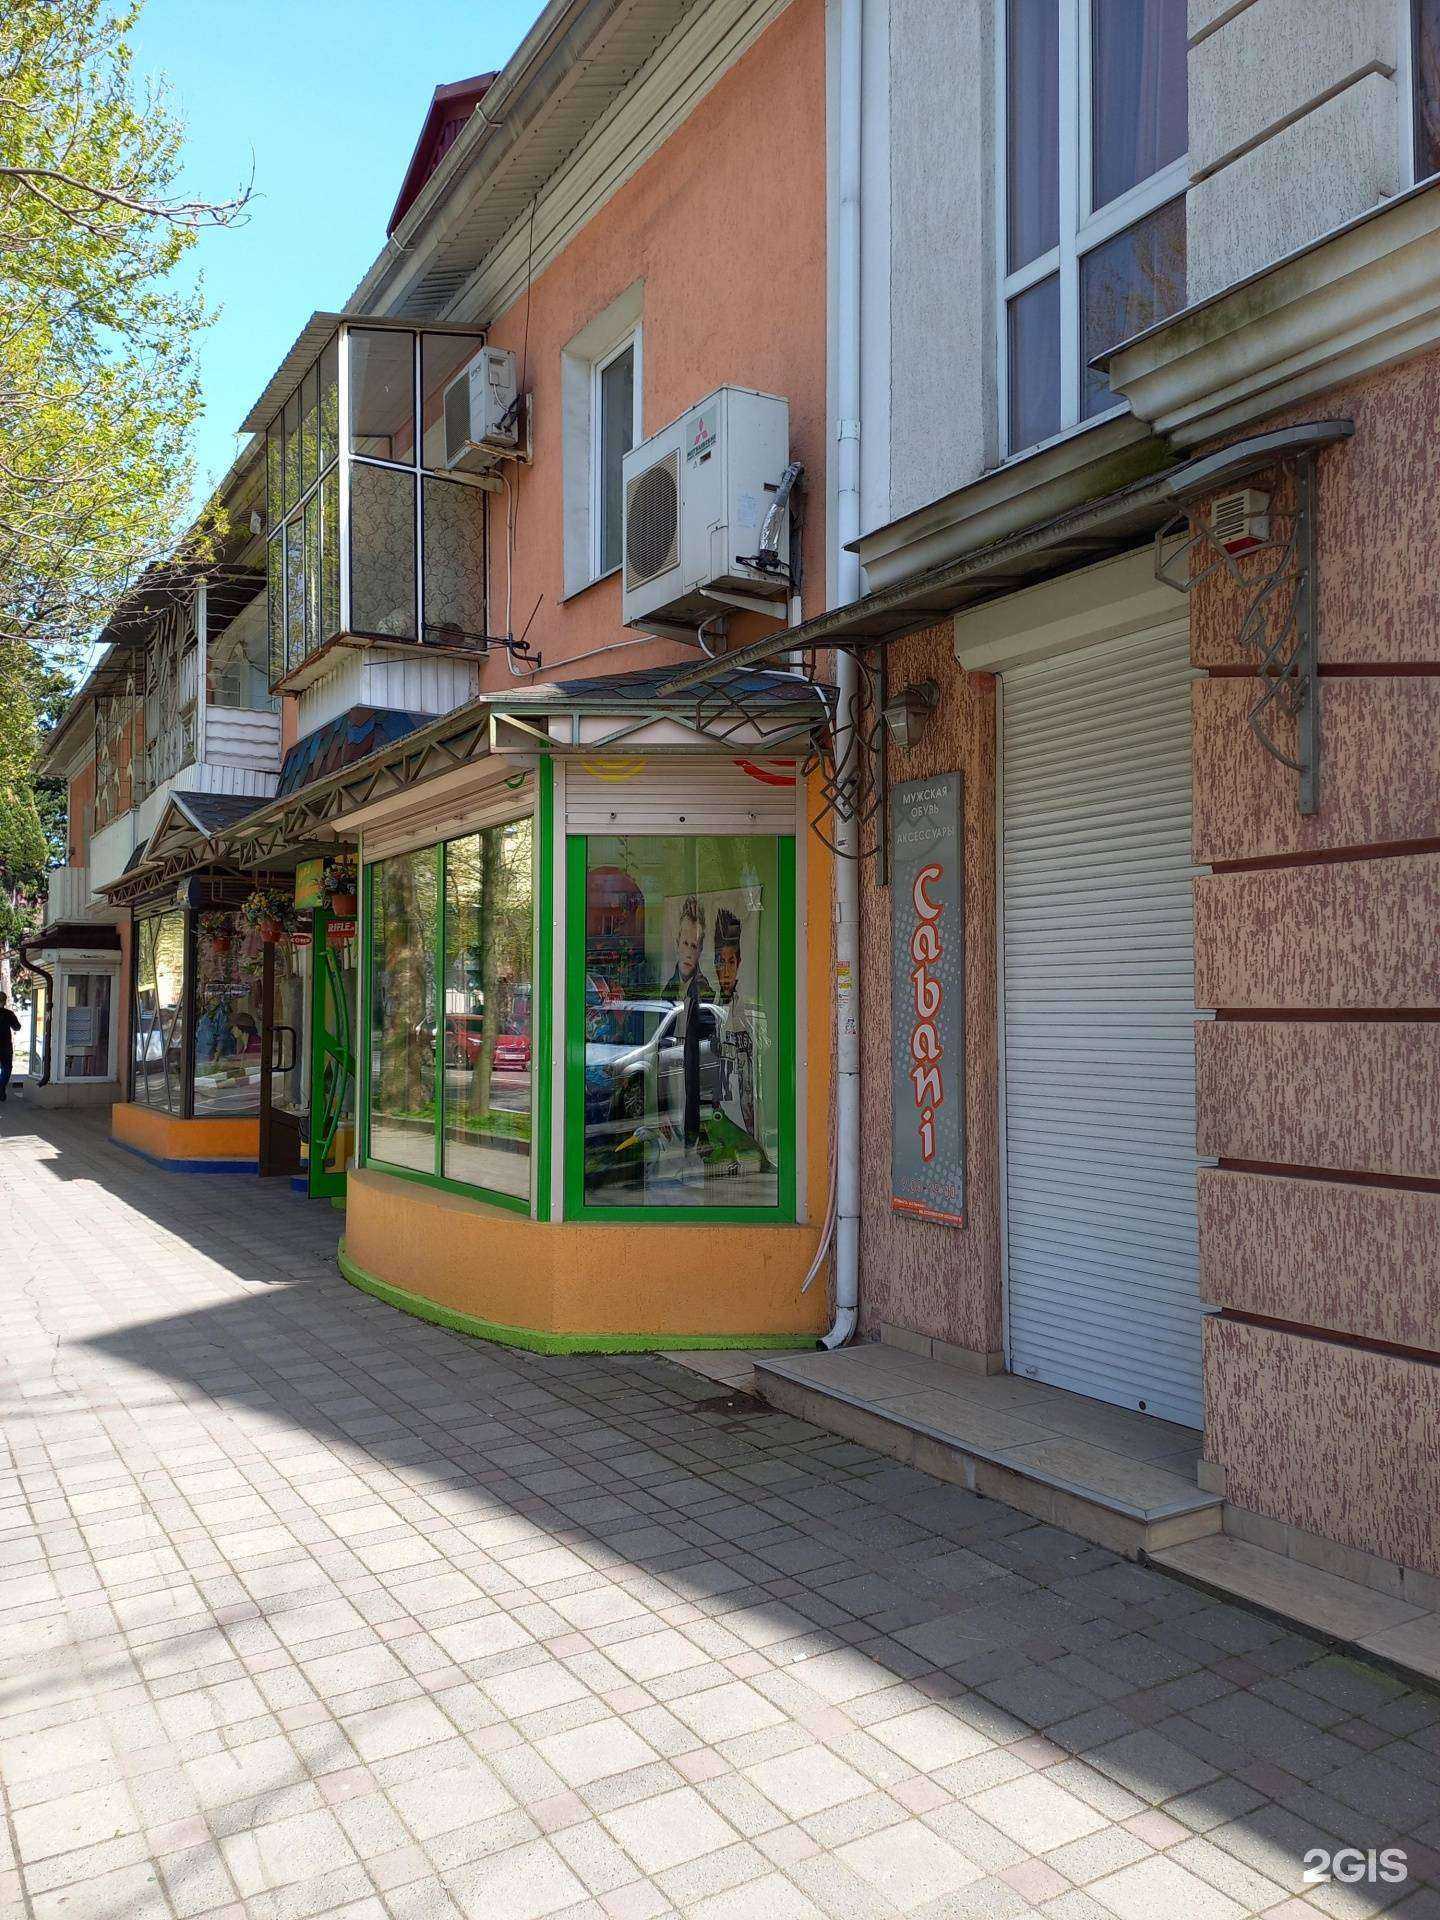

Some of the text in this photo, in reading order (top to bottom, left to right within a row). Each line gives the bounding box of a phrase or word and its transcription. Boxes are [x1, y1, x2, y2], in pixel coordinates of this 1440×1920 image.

[902, 786, 948, 805] МУЖСКАЯ
[911, 803, 940, 818] ОБУВЬ
[896, 825, 954, 845] АКСЕССУАРЫ
[911, 863, 945, 1162] Cabani
